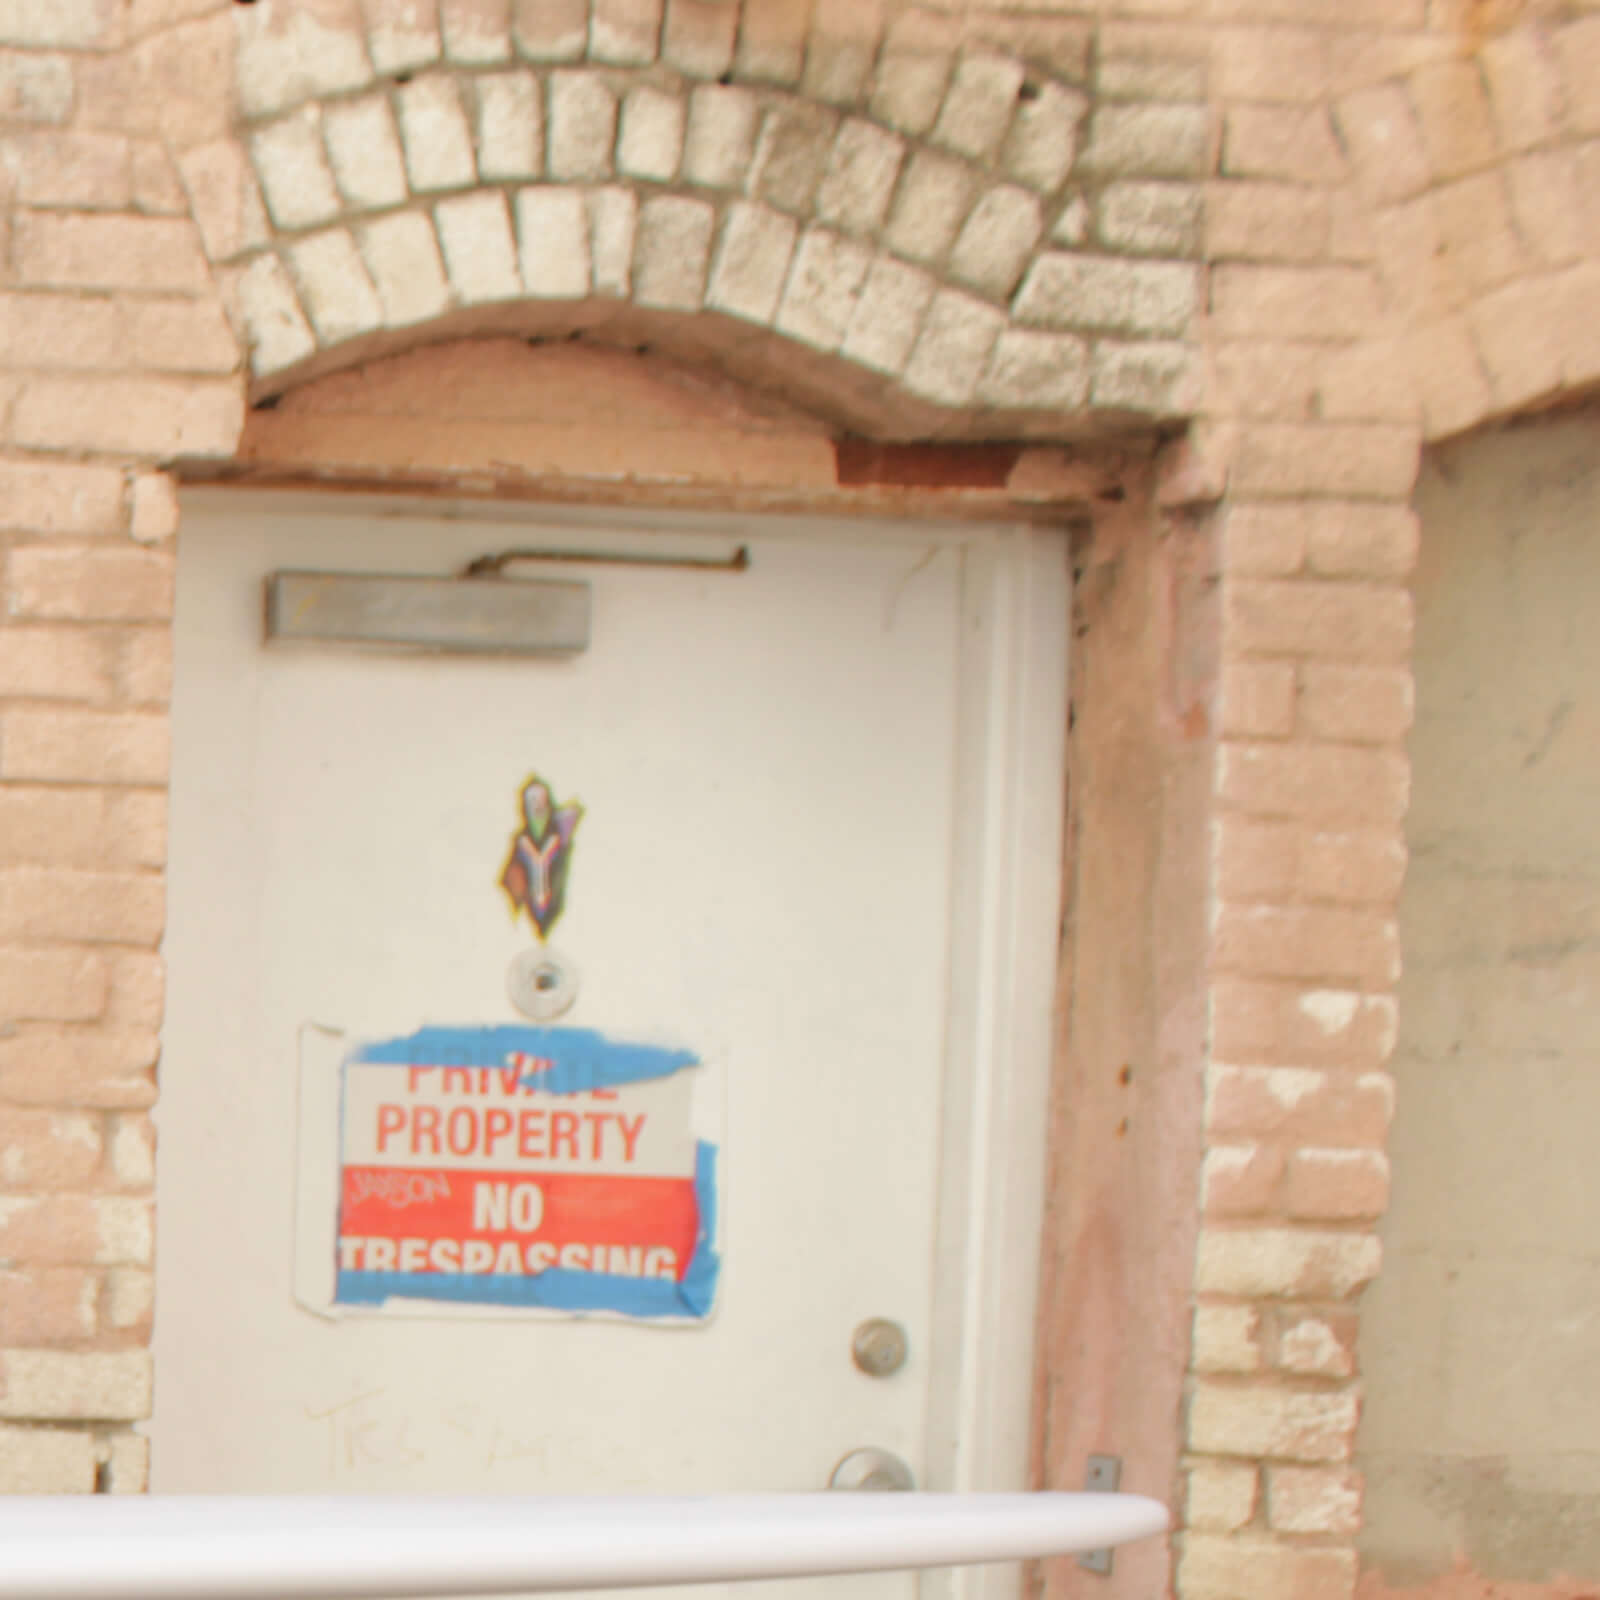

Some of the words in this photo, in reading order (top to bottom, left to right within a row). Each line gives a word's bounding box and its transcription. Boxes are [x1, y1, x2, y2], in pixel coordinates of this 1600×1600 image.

[406, 1048, 619, 1100] PRIV
[375, 1103, 647, 1162] PROPERTY
[472, 1181, 545, 1233] NO
